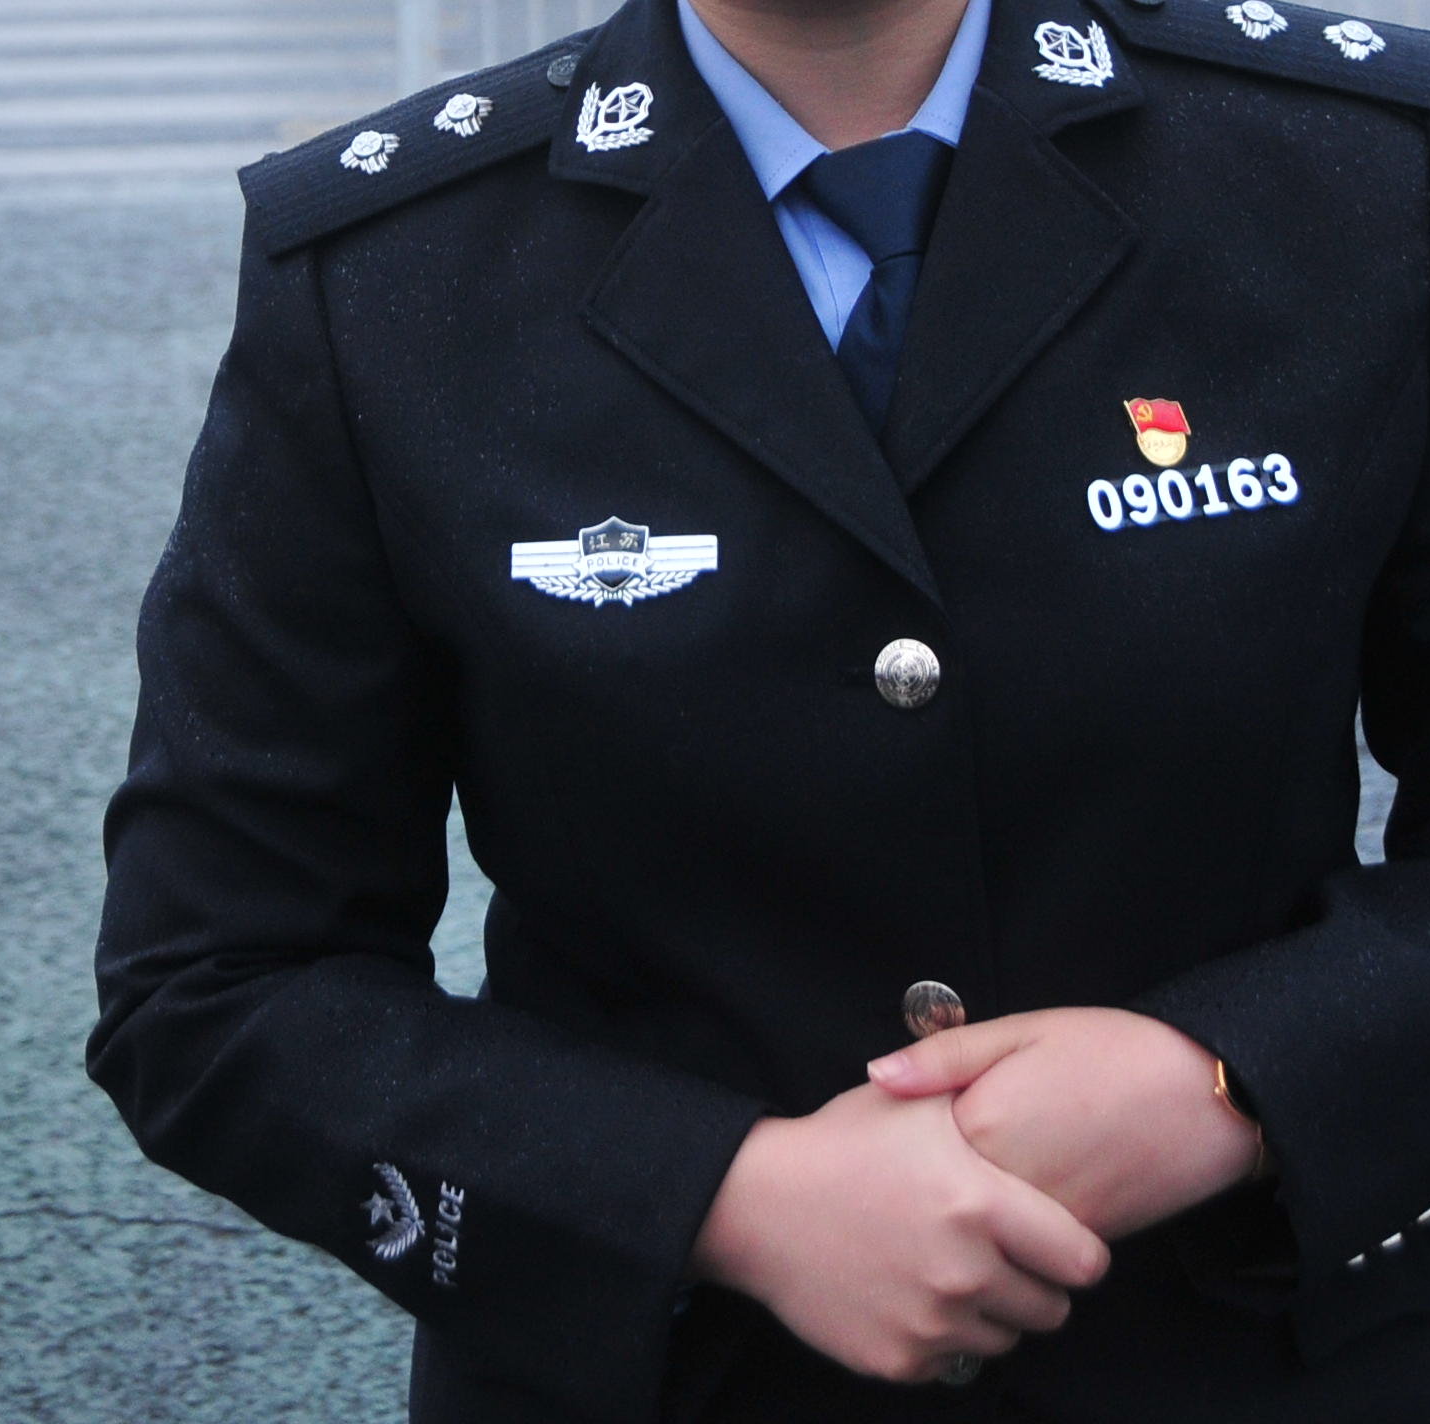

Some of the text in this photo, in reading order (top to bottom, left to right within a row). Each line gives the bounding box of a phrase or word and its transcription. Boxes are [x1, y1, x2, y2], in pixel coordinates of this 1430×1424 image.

[1086, 452, 1300, 532] 090163
[586, 555, 639, 568] POLICE
[589, 531, 639, 550] 江苏
[433, 1181, 464, 1286] POLICE
